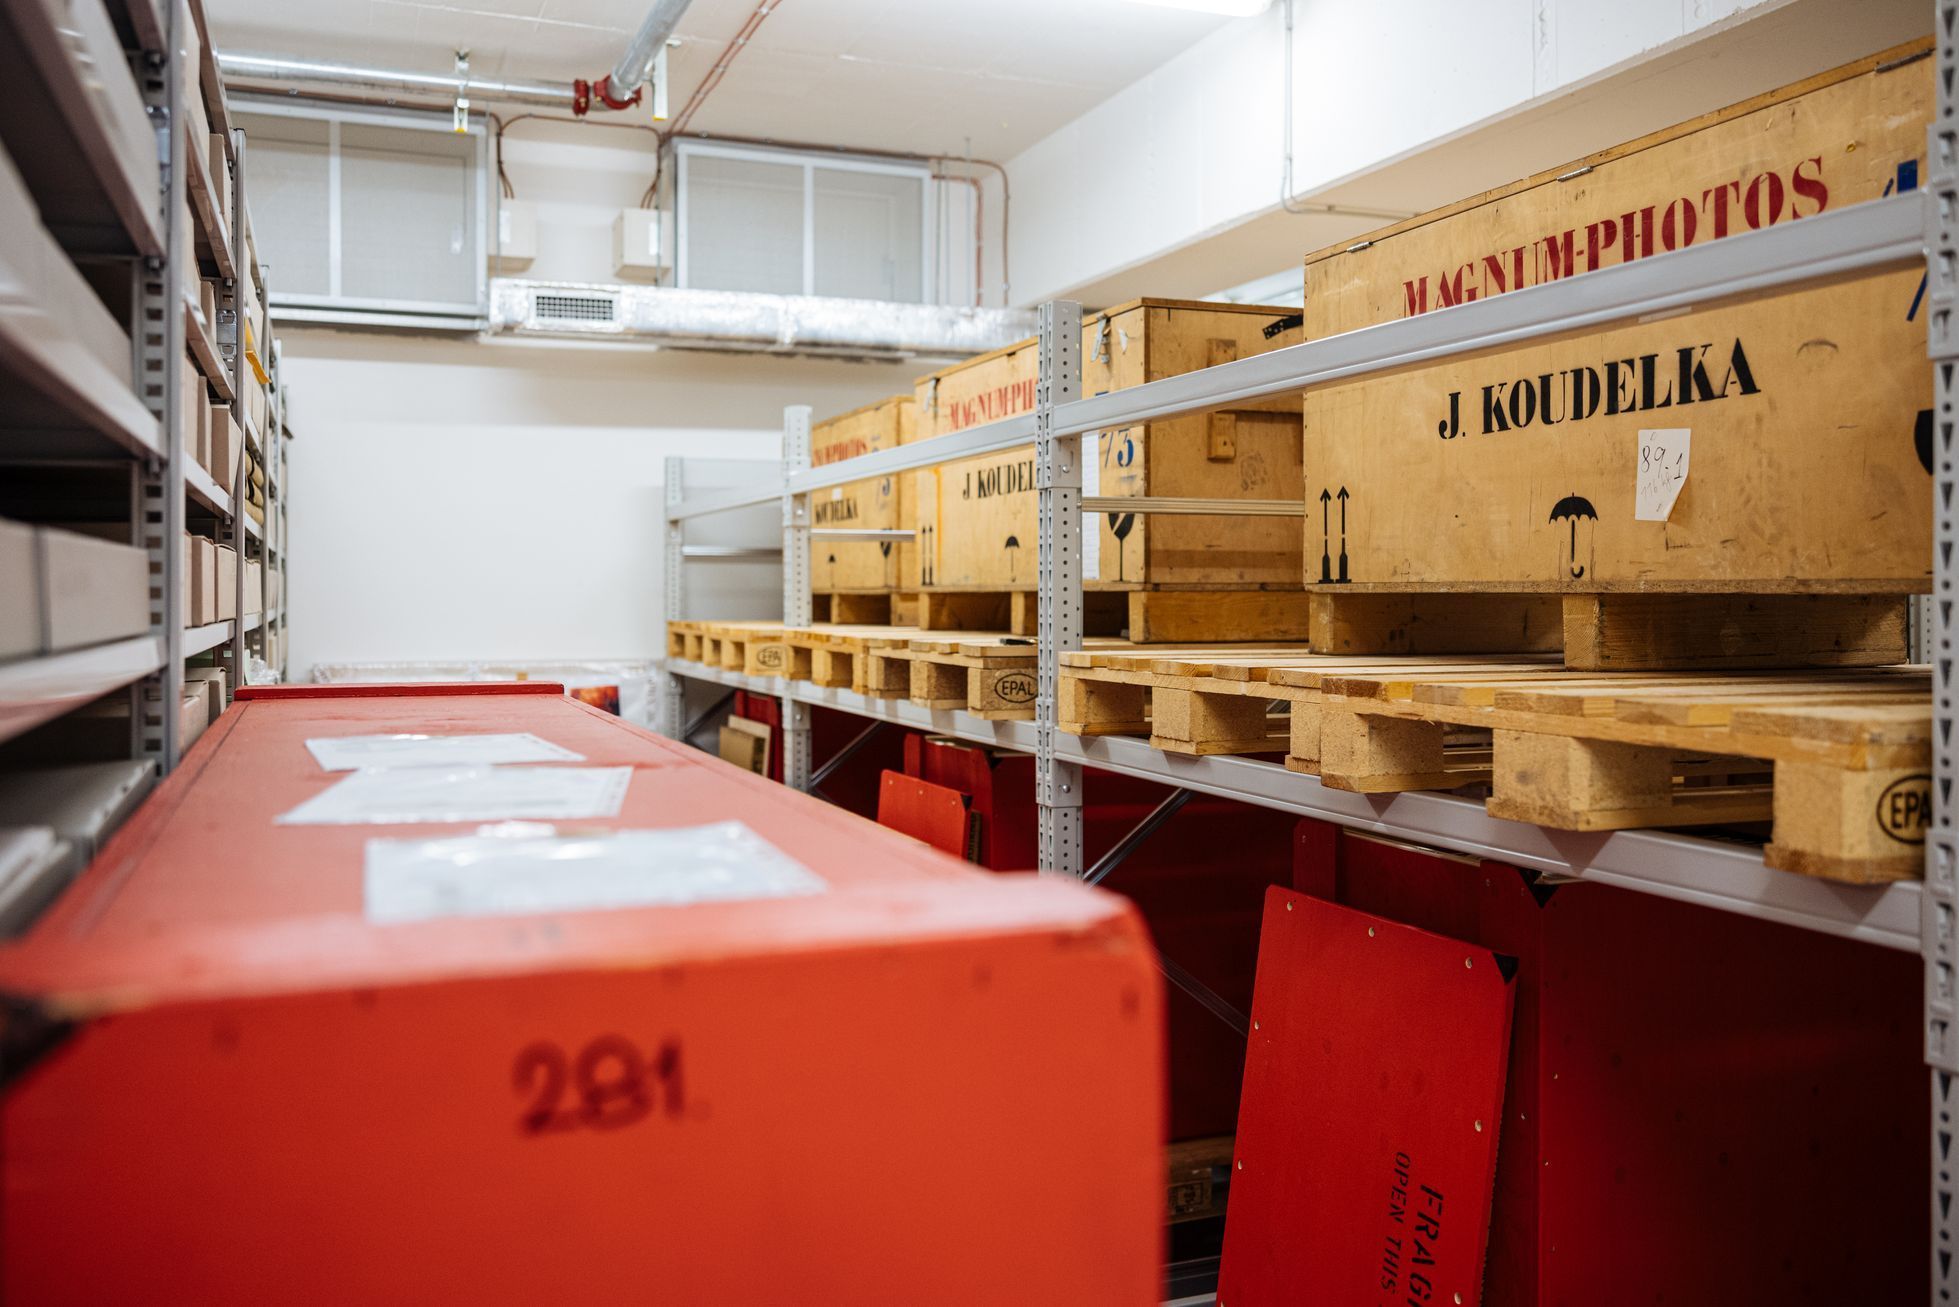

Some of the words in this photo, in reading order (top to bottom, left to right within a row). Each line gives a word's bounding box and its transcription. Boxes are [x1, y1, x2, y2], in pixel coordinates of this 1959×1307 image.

[1402, 156, 1829, 318] MAGNUM-PHOTOS
[1438, 391, 1466, 439] J.
[1481, 337, 1761, 434] KOUDELKA
[1002, 680, 1035, 696] EPAL
[511, 1034, 686, 1136] 281
[1389, 1152, 1411, 1223] OPEN
[1381, 1236, 1401, 1293] THIS
